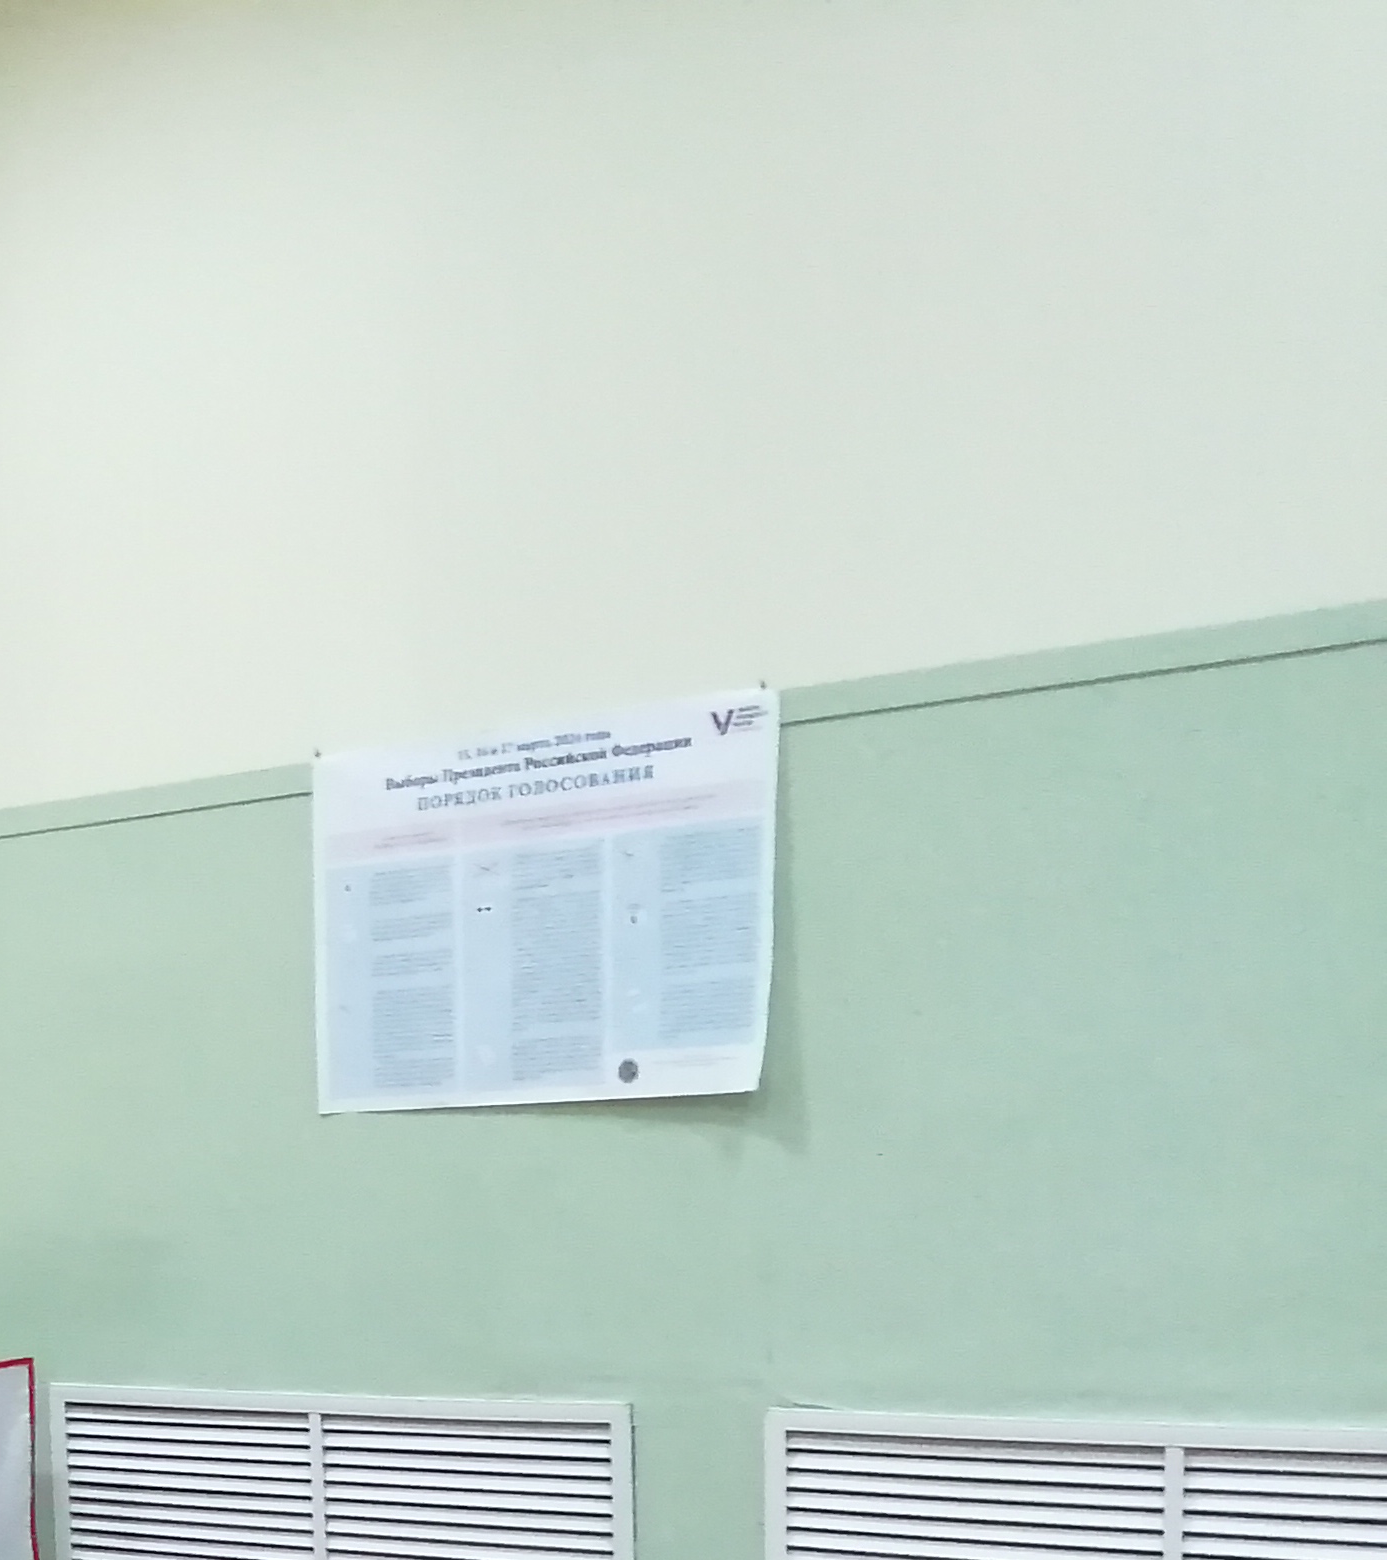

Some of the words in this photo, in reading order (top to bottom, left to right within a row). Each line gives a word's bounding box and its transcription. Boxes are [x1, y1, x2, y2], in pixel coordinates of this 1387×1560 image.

[385, 774, 438, 791] Выборы
[442, 763, 521, 785] Президента
[524, 748, 607, 770] Российской
[611, 737, 692, 757] Федерации
[417, 787, 502, 811] ПОРЯДОК
[508, 765, 654, 798] ГОЛОСОВАНИЯ
